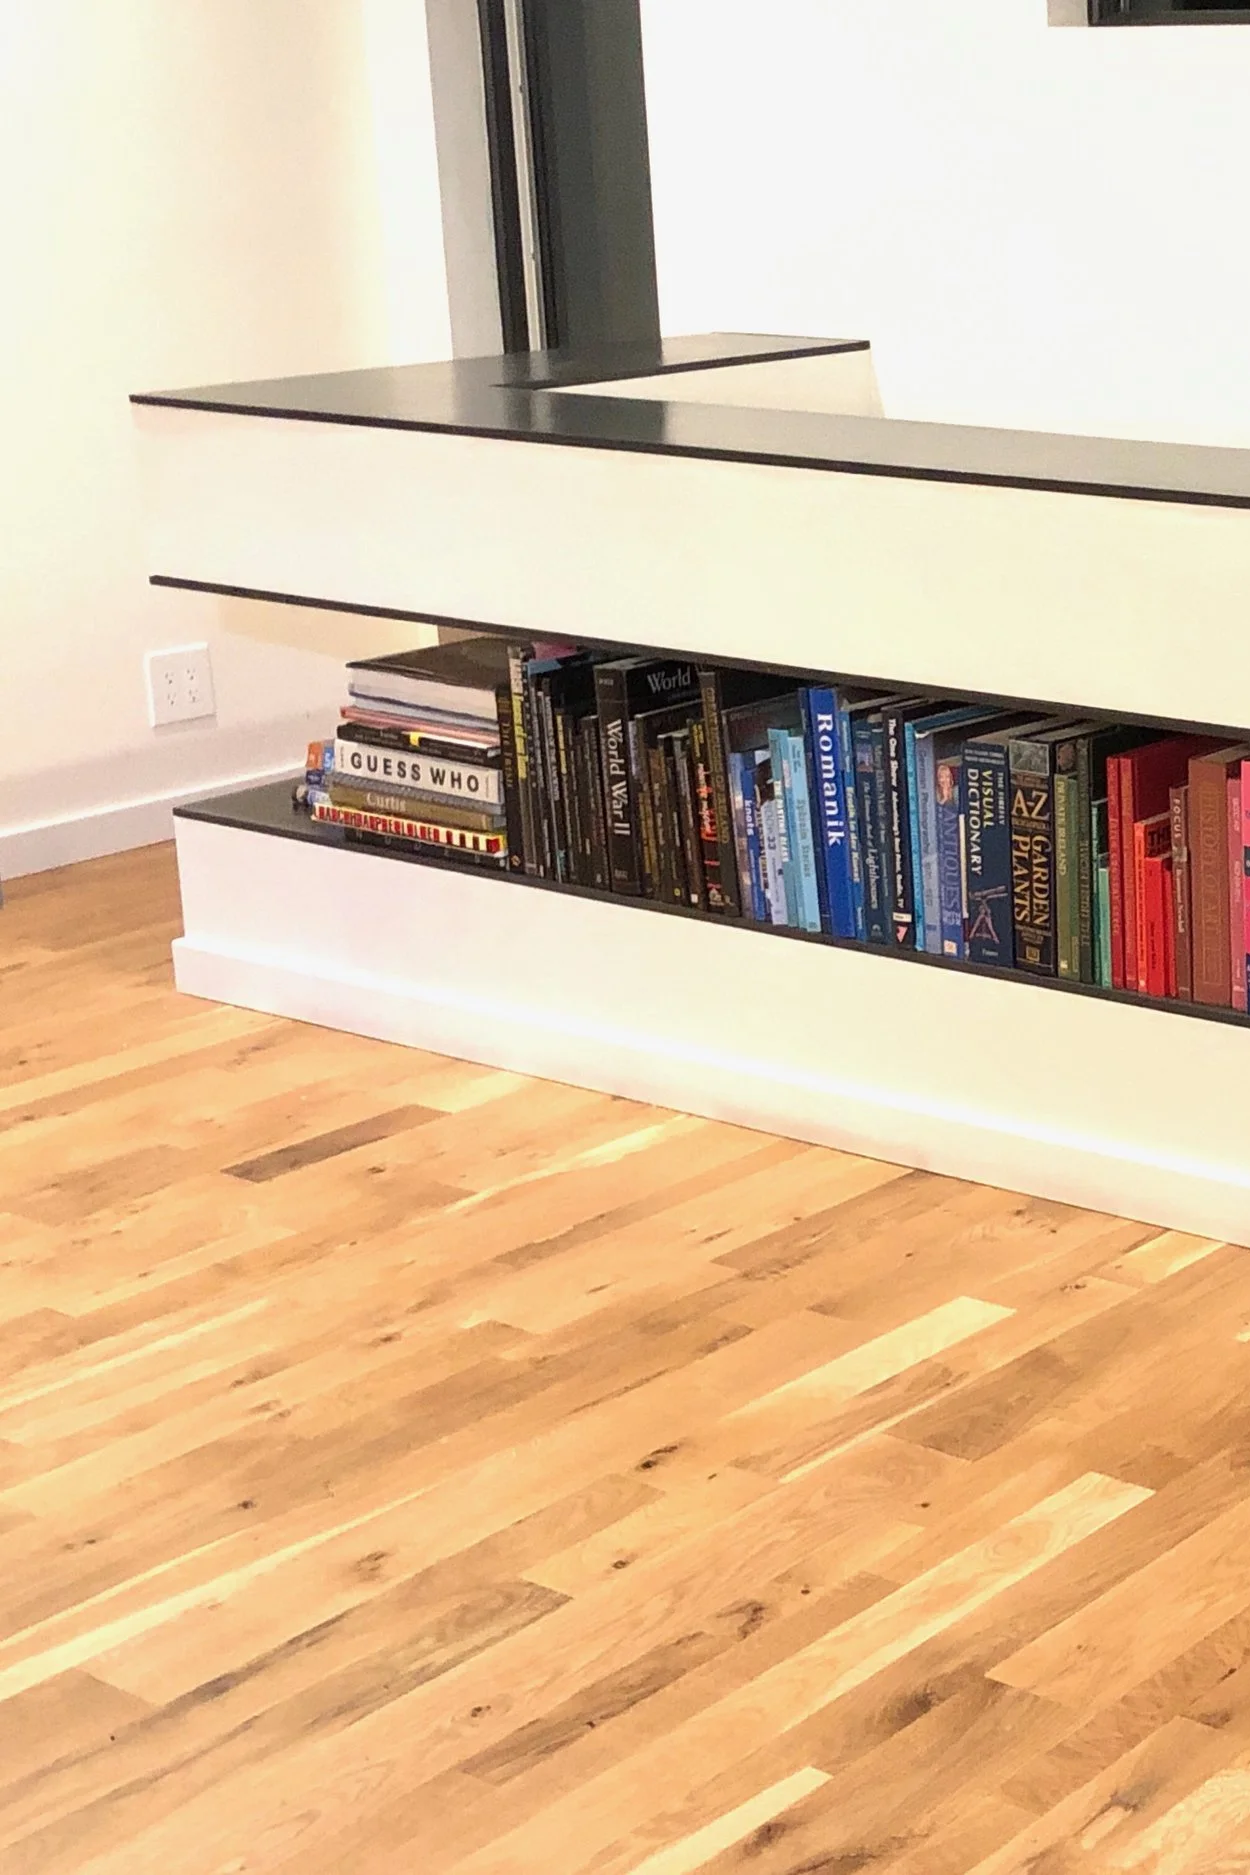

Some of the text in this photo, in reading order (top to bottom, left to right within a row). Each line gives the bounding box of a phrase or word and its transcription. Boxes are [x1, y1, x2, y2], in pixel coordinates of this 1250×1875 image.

[647, 667, 691, 694] World
[887, 718, 897, 735] The
[889, 738, 898, 757] One
[350, 752, 480, 793] GUESS WHO
[606, 719, 630, 836] World War II
[817, 713, 845, 846] Romanik
[890, 760, 900, 786] Show
[745, 799, 755, 836] knots
[967, 768, 982, 875] DICTIONARY
[981, 769, 994, 829] VISUAL
[1172, 798, 1182, 838] FOCUS
[943, 807, 960, 907] ANTIQUES
[1058, 826, 1068, 876] IRELAND
[866, 848, 881, 909] Lighthouses
[897, 898, 905, 908] TV
[1011, 834, 1031, 922] PLANTS
[1031, 834, 1051, 926] GARDEN
